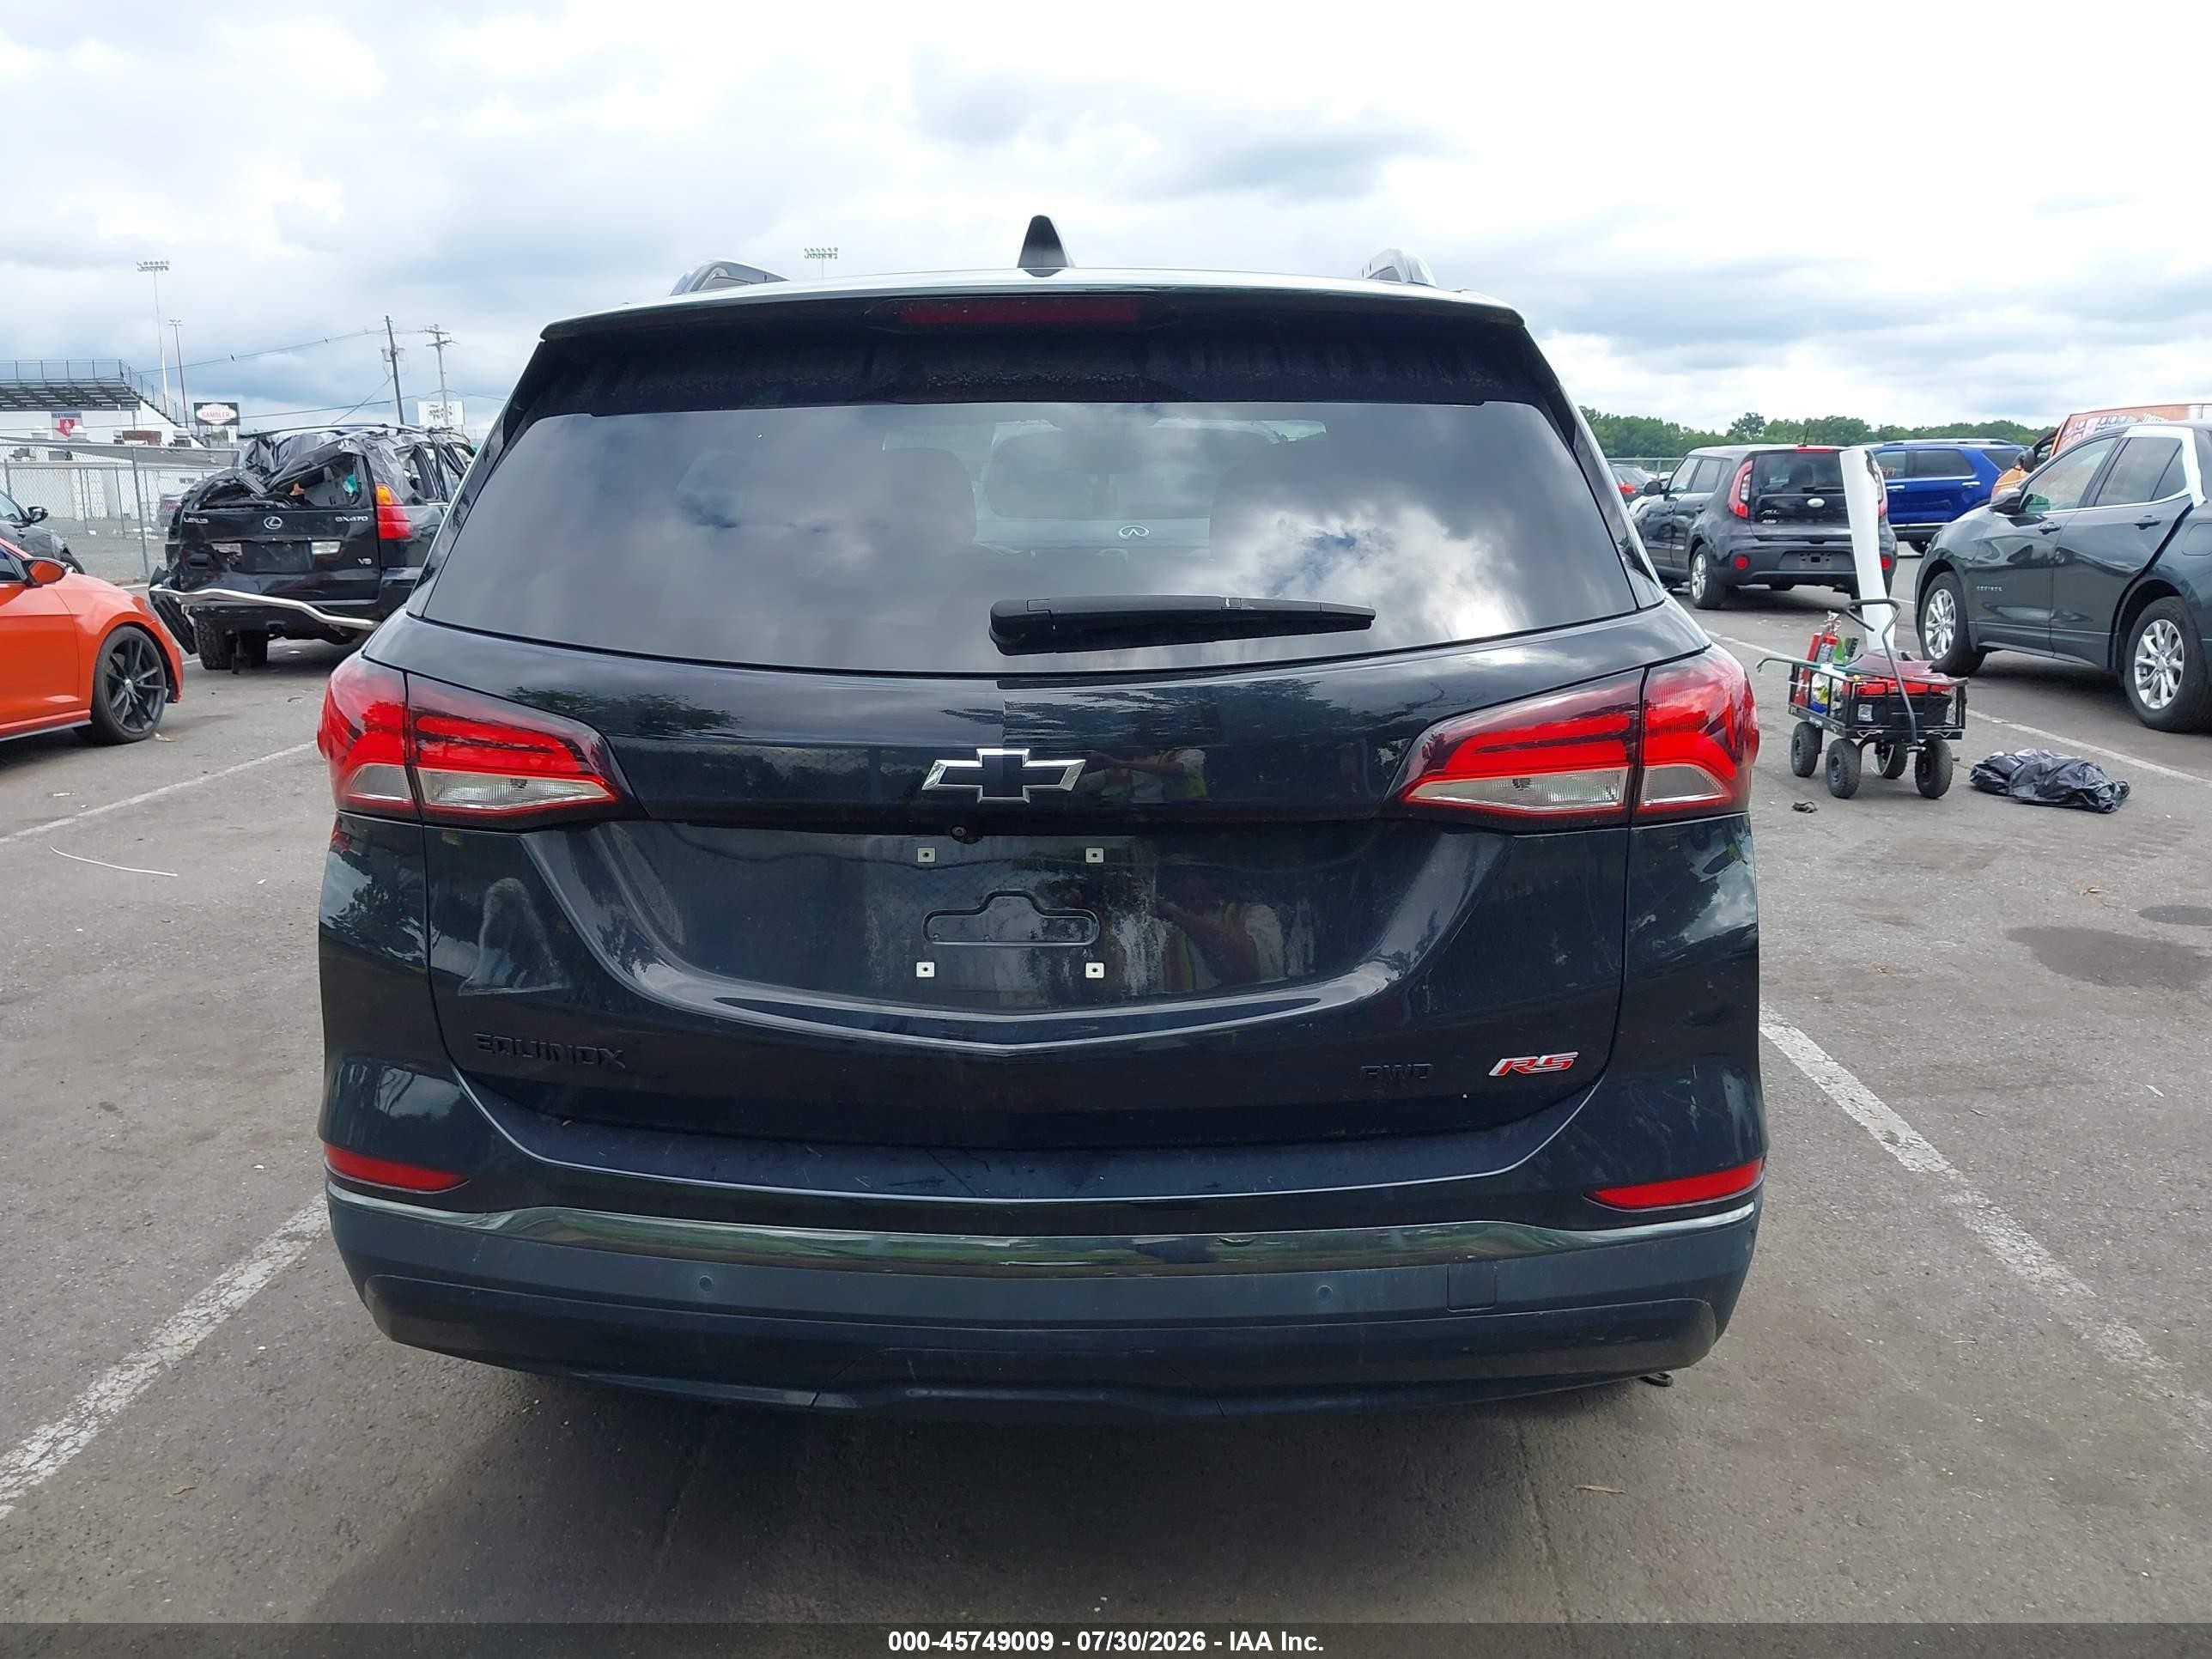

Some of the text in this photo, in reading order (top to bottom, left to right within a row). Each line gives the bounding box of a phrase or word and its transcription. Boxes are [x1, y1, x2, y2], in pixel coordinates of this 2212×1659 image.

[357, 557, 373, 566] V8
[473, 1032, 626, 1069] EQUINOX
[1487, 1050, 1580, 1078] RS
